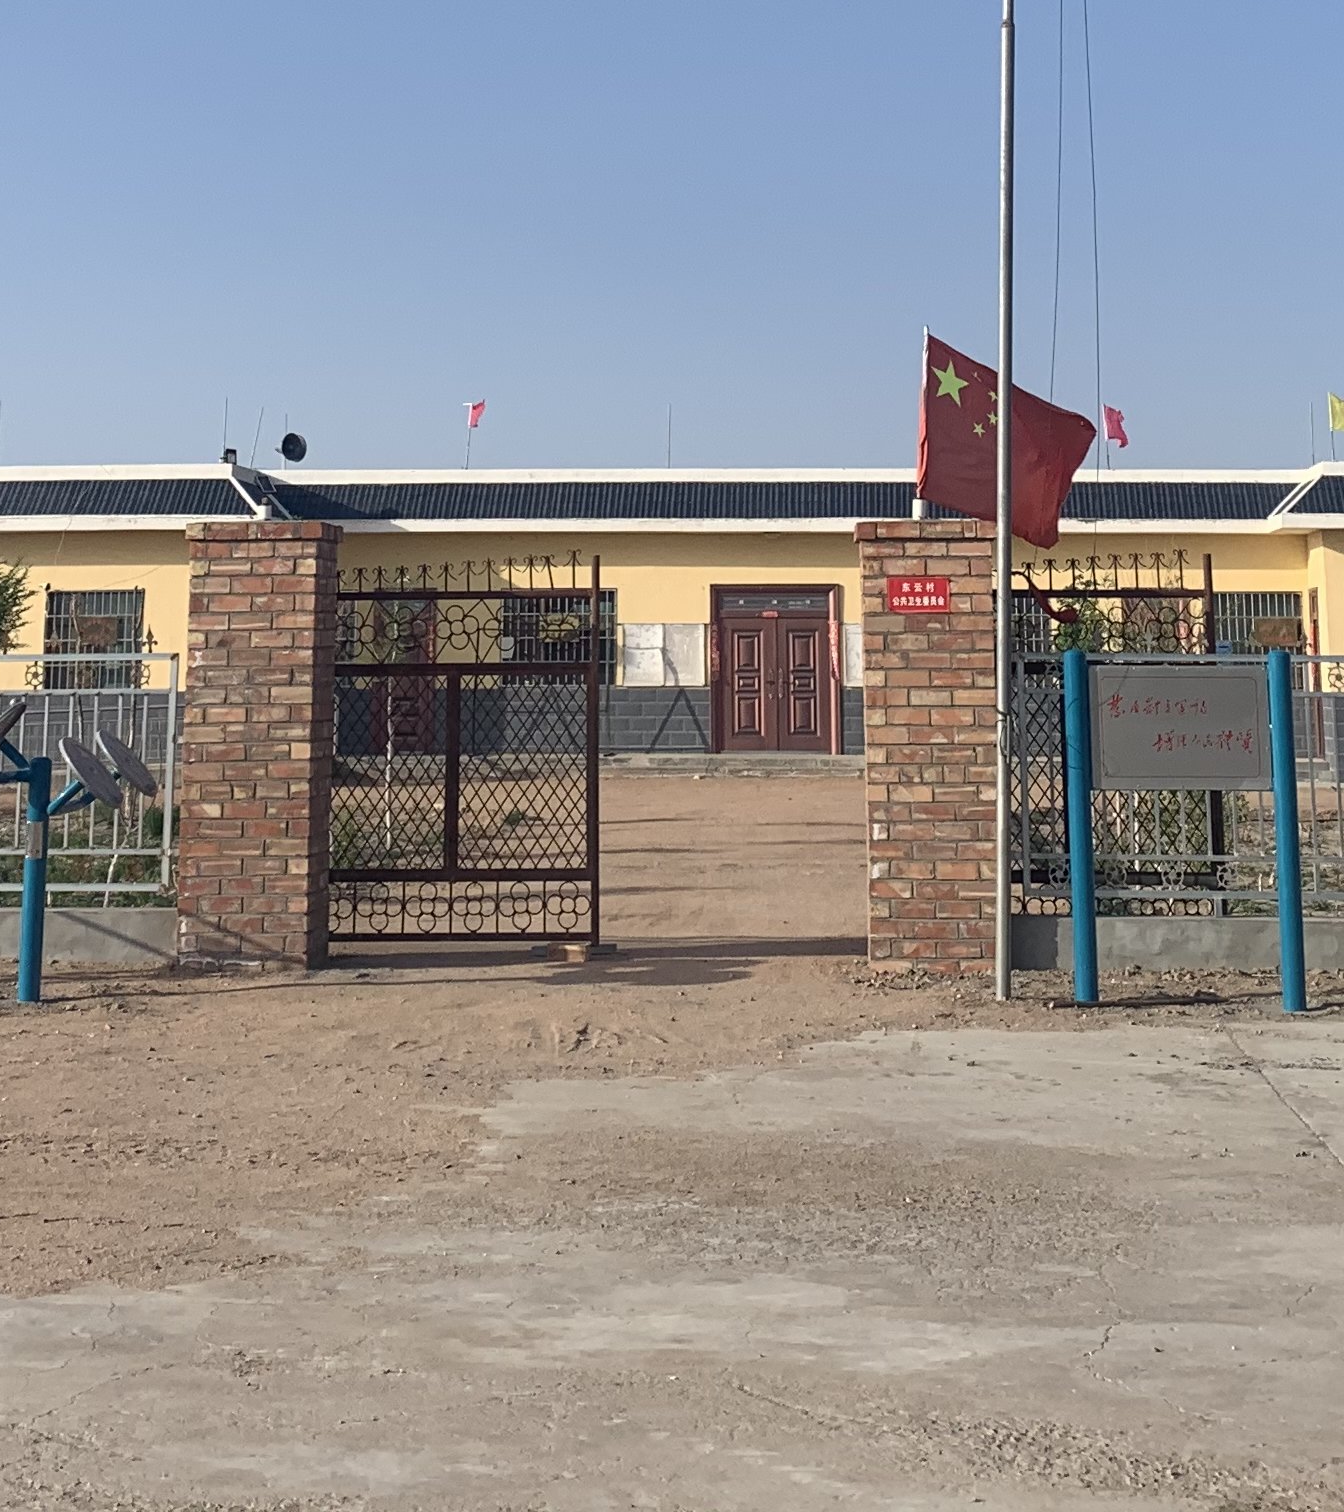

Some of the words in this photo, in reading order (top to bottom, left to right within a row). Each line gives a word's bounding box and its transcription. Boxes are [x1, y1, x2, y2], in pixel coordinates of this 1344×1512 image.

[901, 582, 935, 593] 东云村
[892, 595, 945, 606] 公共卫生委员会
